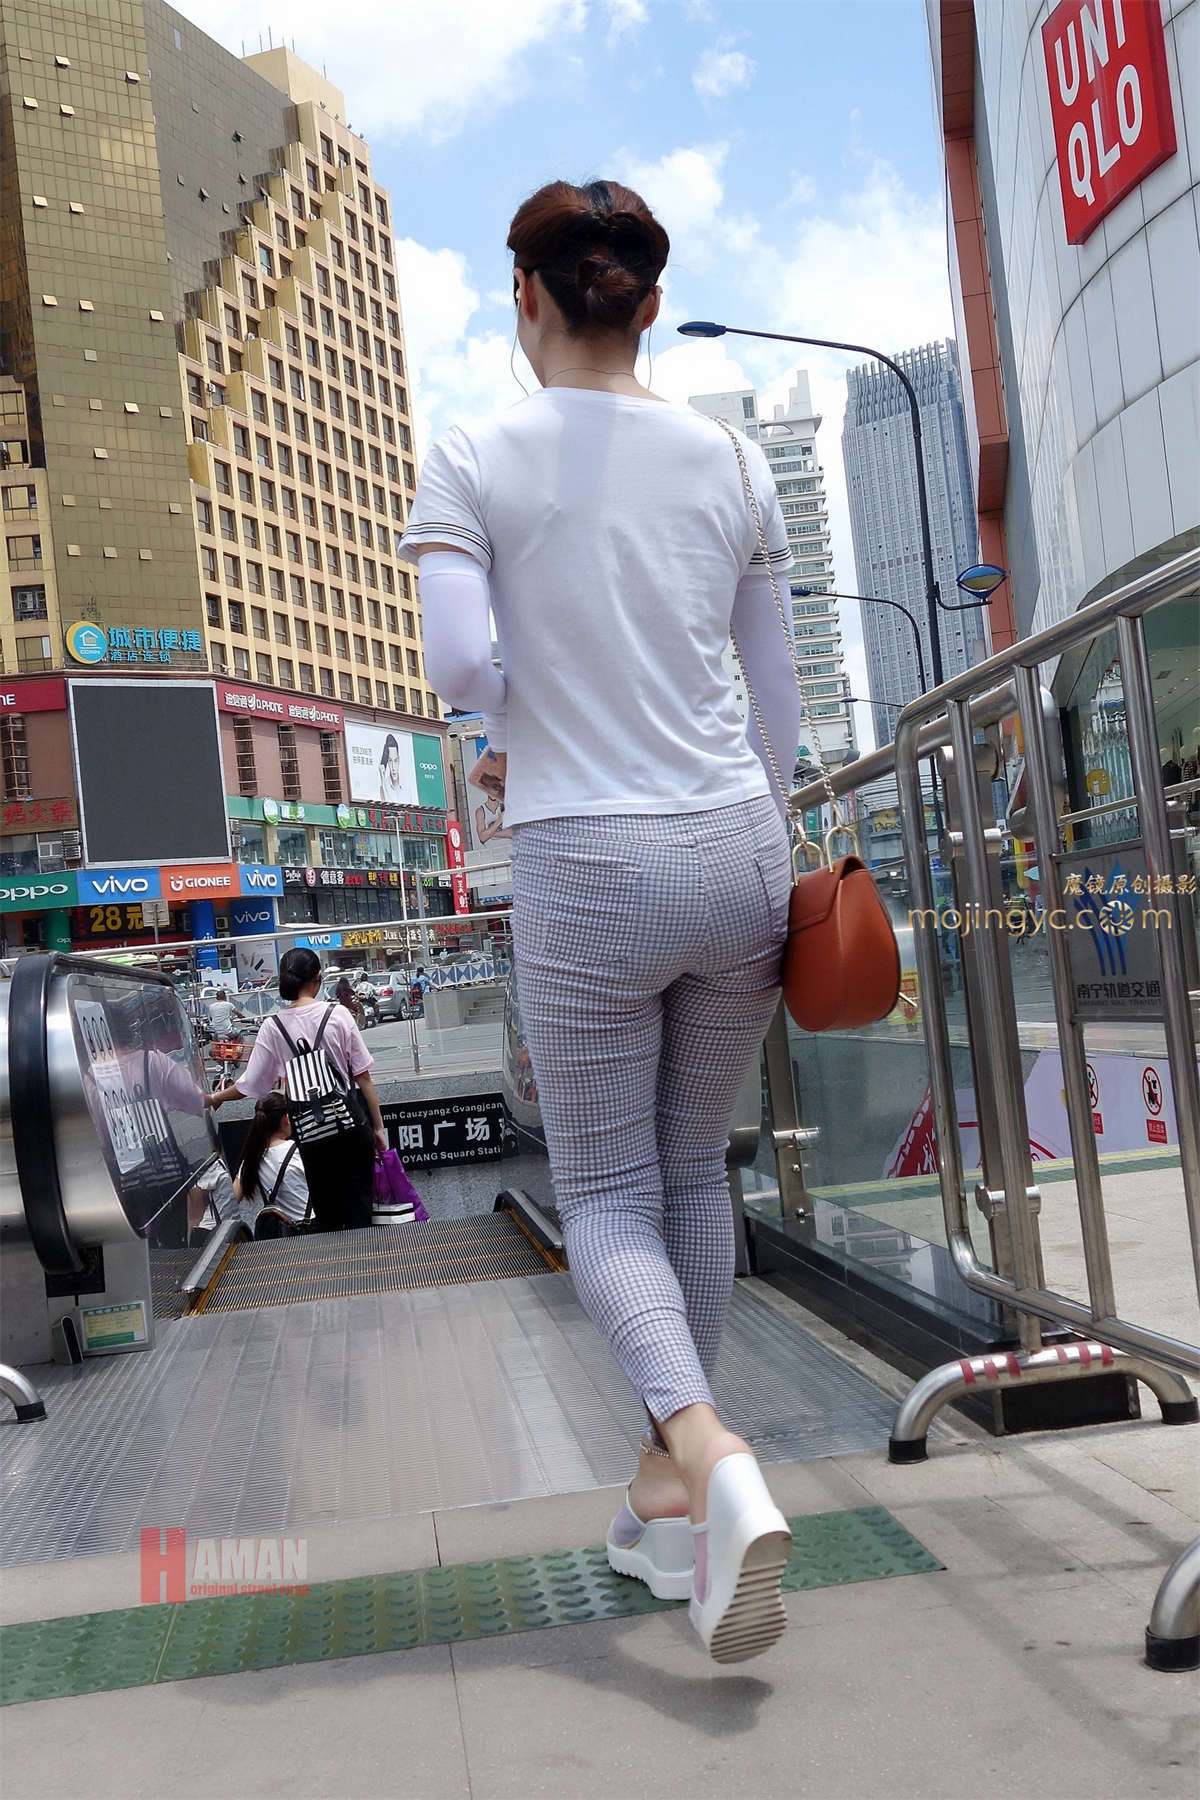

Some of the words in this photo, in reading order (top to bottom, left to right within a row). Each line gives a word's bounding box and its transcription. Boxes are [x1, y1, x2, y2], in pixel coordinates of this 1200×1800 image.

[1055, 0, 1126, 106] UNI
[1068, 65, 1143, 206] QLO
[109, 627, 202, 652] 城市便捷
[92, 875, 149, 894] vivo
[185, 876, 232, 888] GIONEE
[246, 869, 278, 887] vivo
[234, 911, 271, 924] vivo
[307, 934, 331, 945] vivo
[1077, 981, 1161, 999] 南宁轨道交通
[399, 1107, 451, 1119] Cauzyangz
[383, 1116, 505, 1150] 阳广场
[440, 1149, 476, 1160] Square
